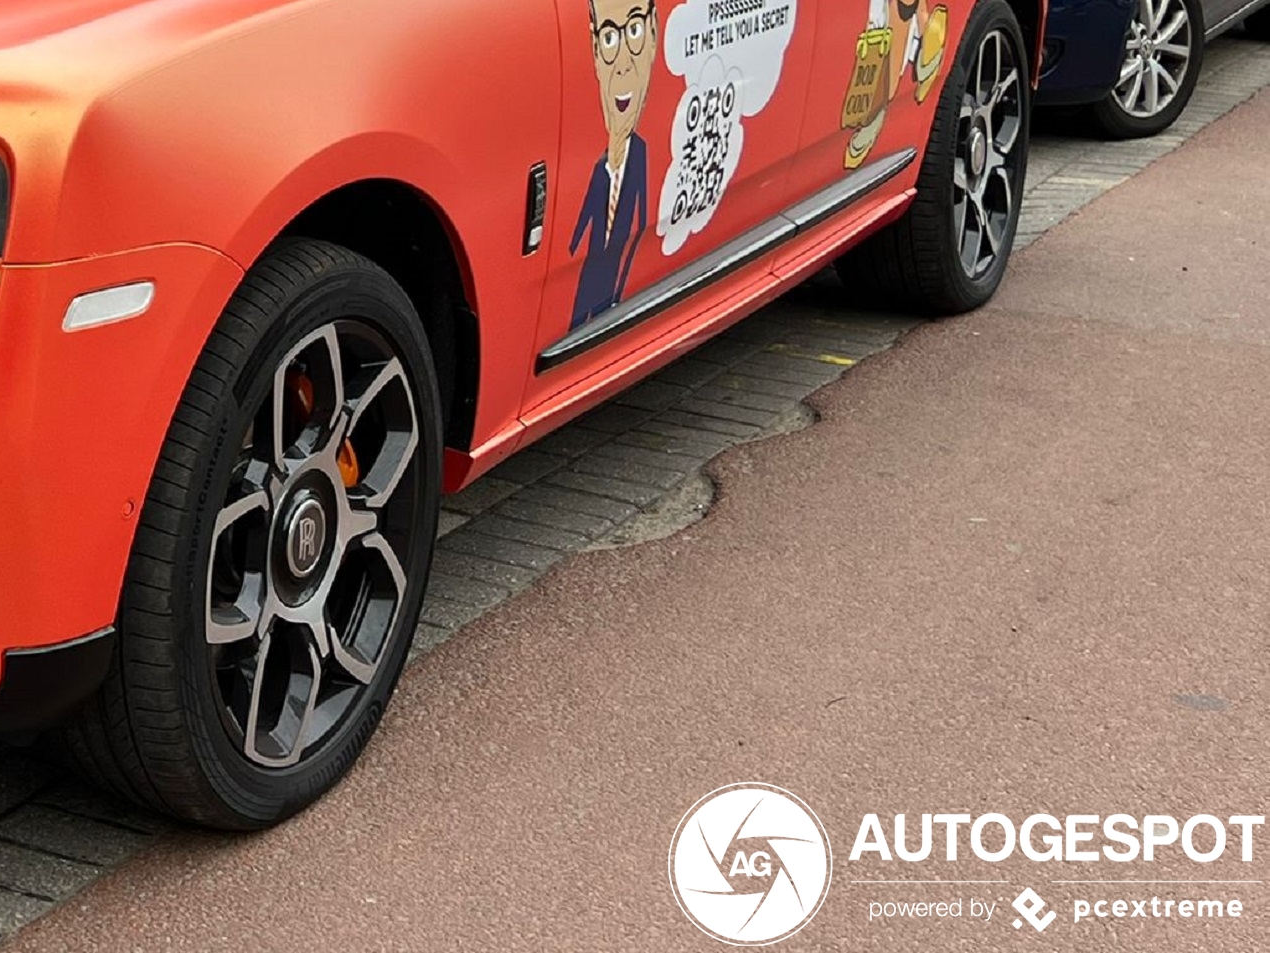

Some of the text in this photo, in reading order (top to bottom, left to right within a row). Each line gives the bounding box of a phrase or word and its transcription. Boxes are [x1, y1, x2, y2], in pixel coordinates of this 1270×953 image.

[685, 4, 790, 58] LET ME TELL YOU A SECRET
[854, 64, 877, 87] BOB
